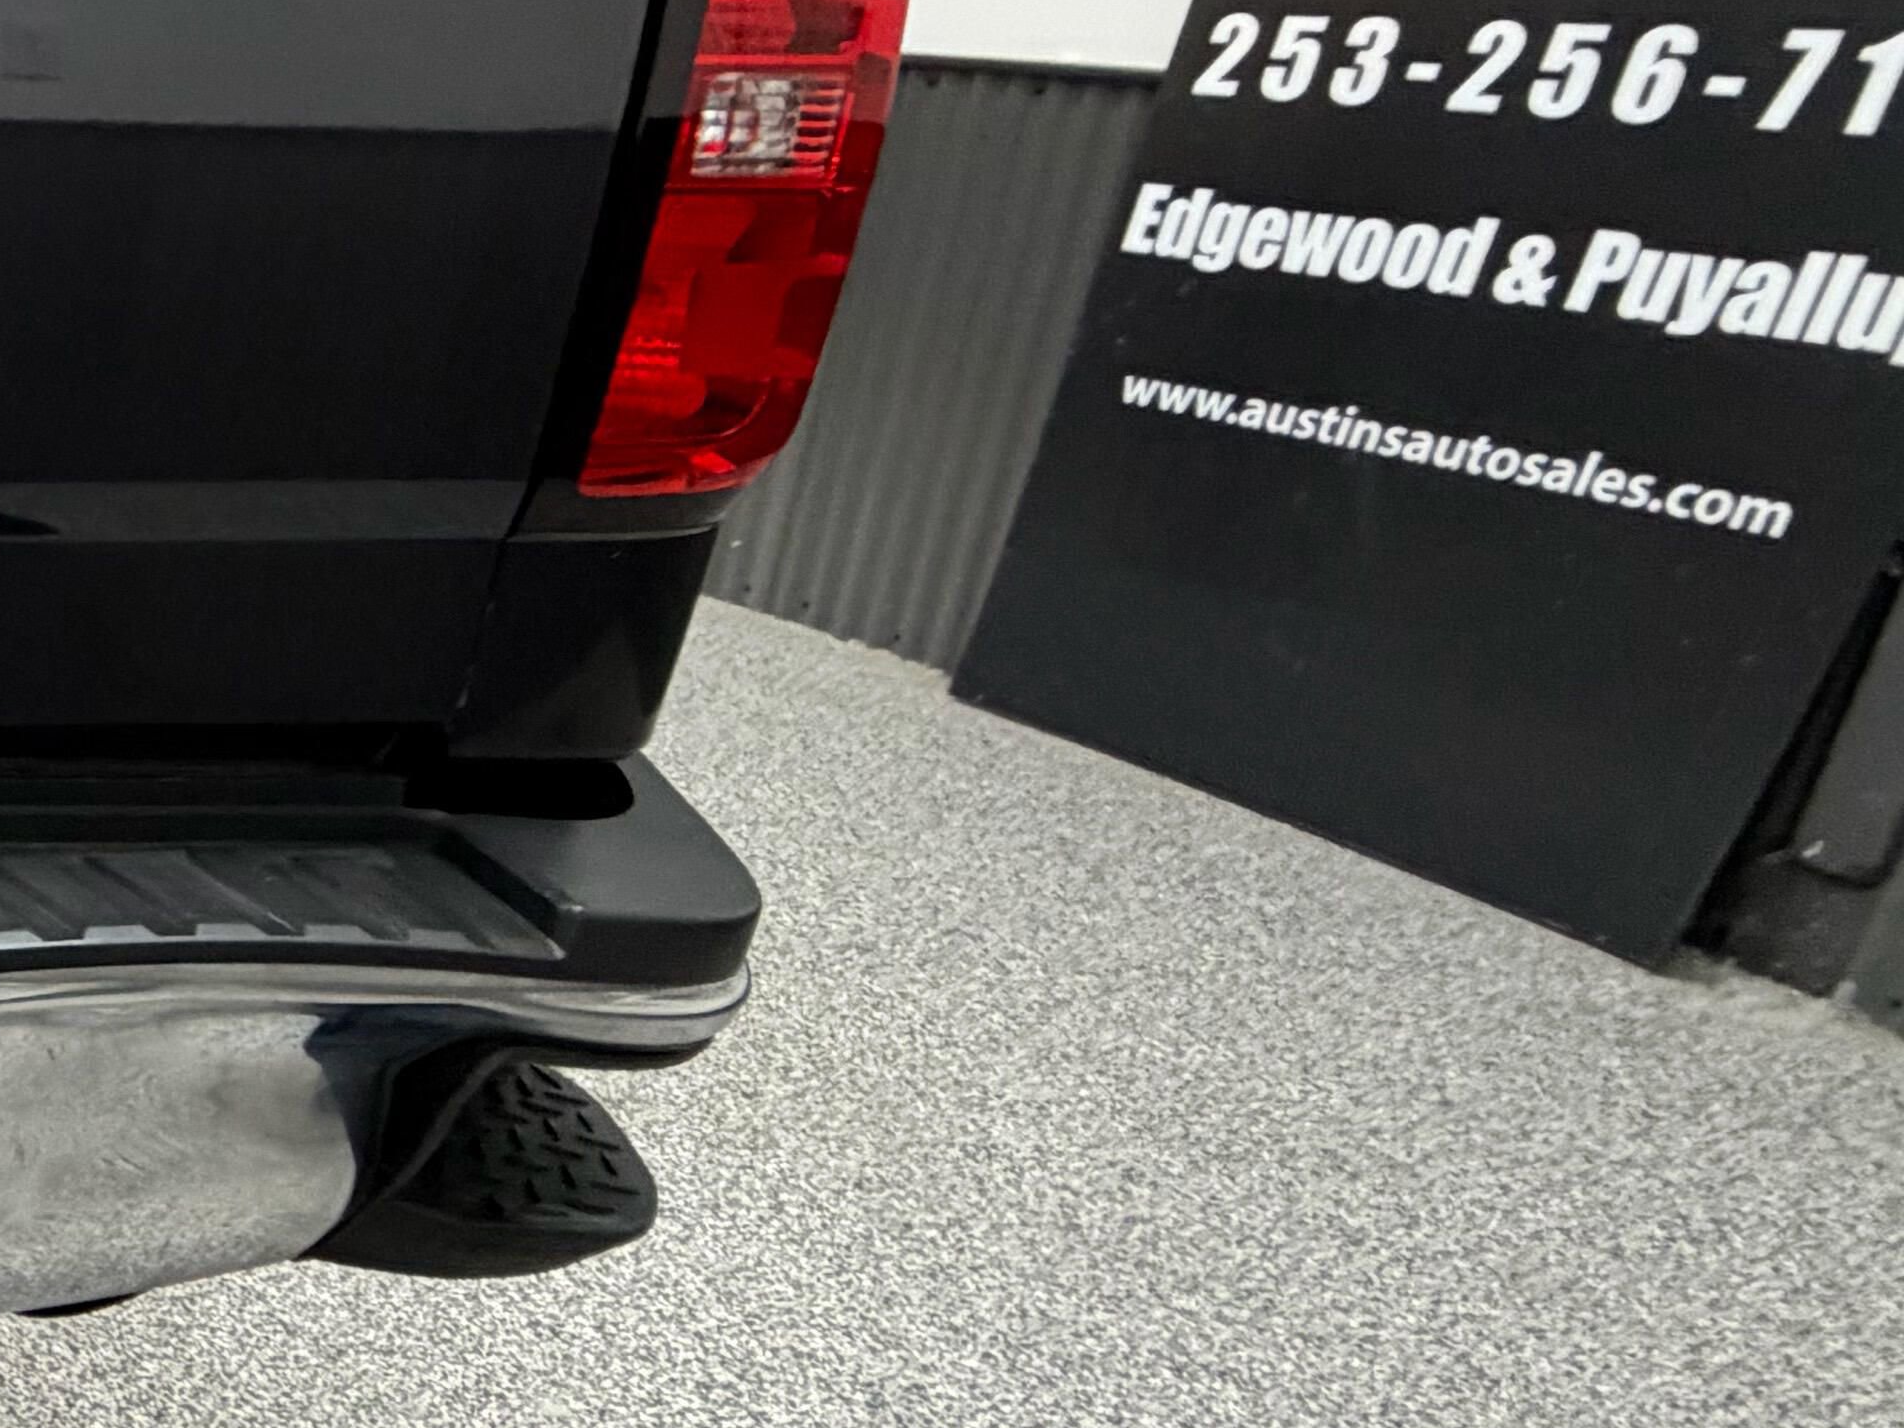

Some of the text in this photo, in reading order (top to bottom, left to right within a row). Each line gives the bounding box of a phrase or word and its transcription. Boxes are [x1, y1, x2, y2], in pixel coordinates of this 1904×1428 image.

[1121, 183, 1500, 296] Edgewood
[1492, 234, 1556, 307] &
[1121, 374, 1793, 539] www.austinsautosales.com
